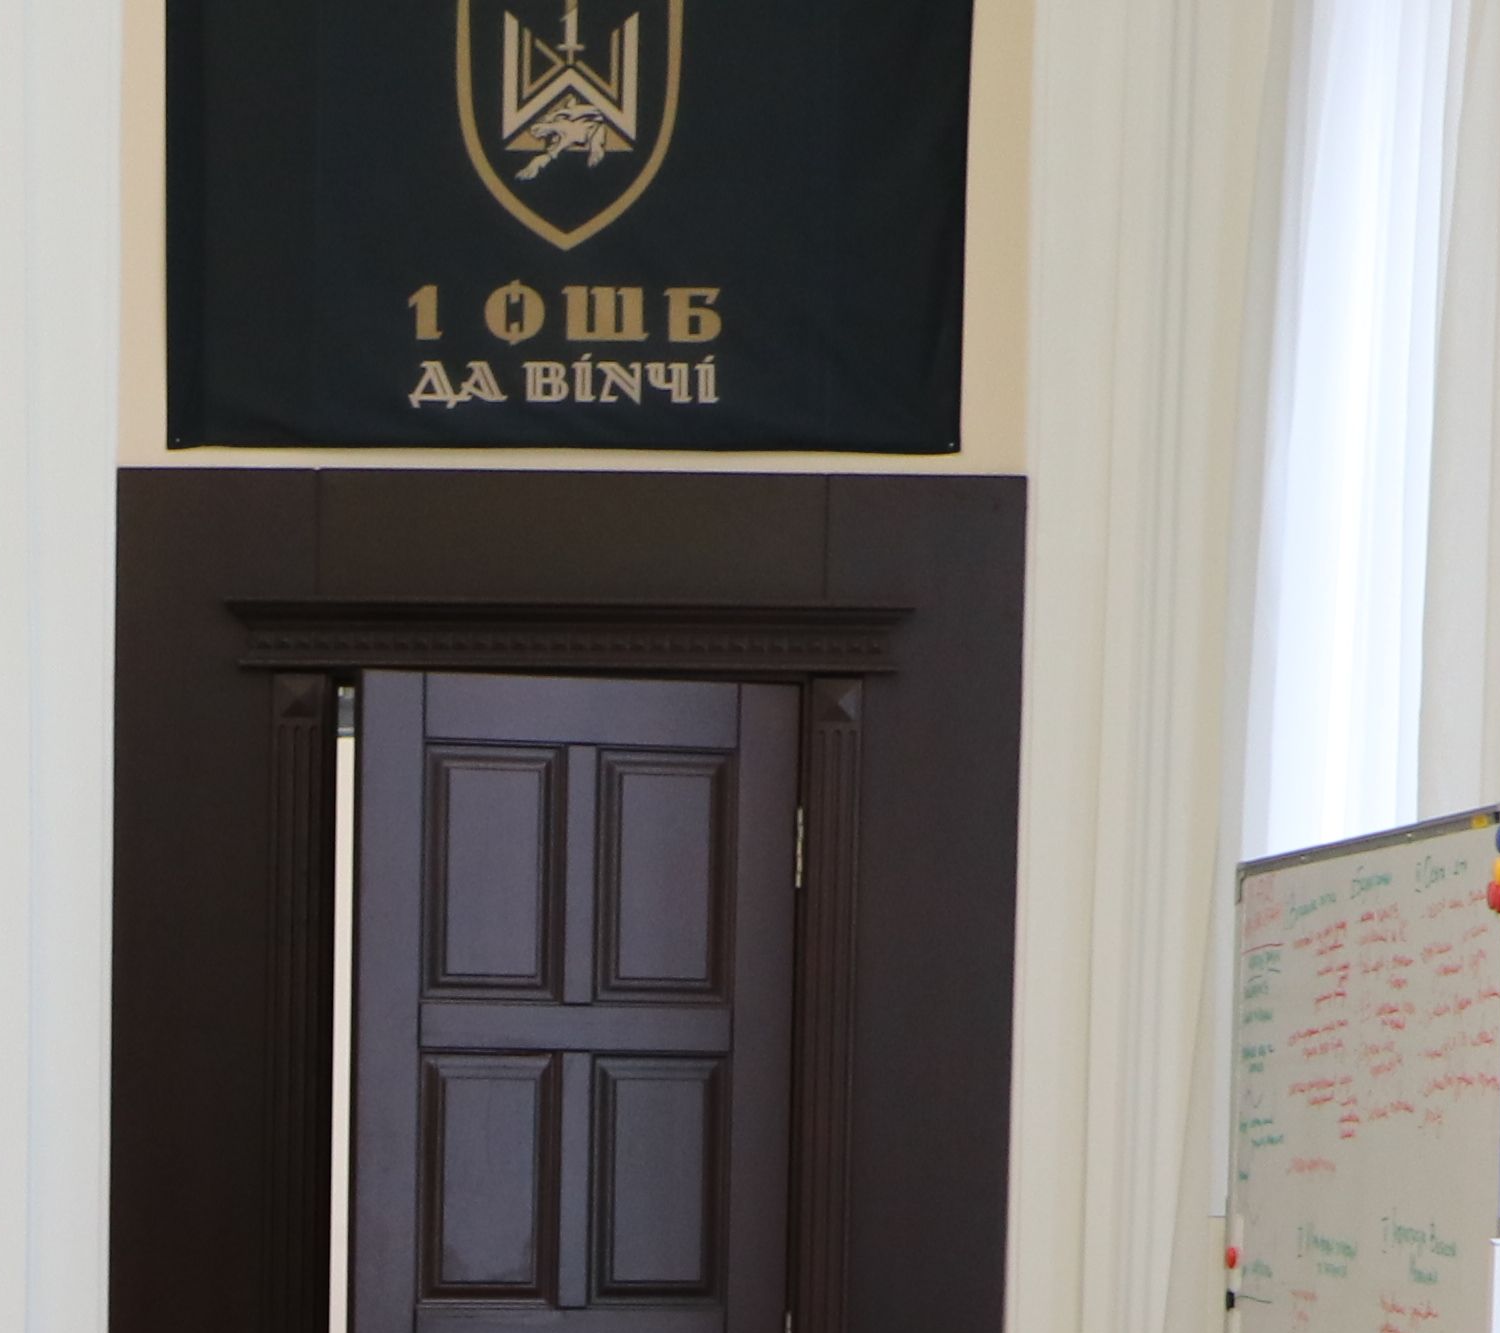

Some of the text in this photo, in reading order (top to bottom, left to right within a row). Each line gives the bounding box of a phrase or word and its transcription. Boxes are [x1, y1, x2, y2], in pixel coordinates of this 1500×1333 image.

[408, 279, 723, 345] 1 ОШБ
[408, 360, 508, 410] ДА
